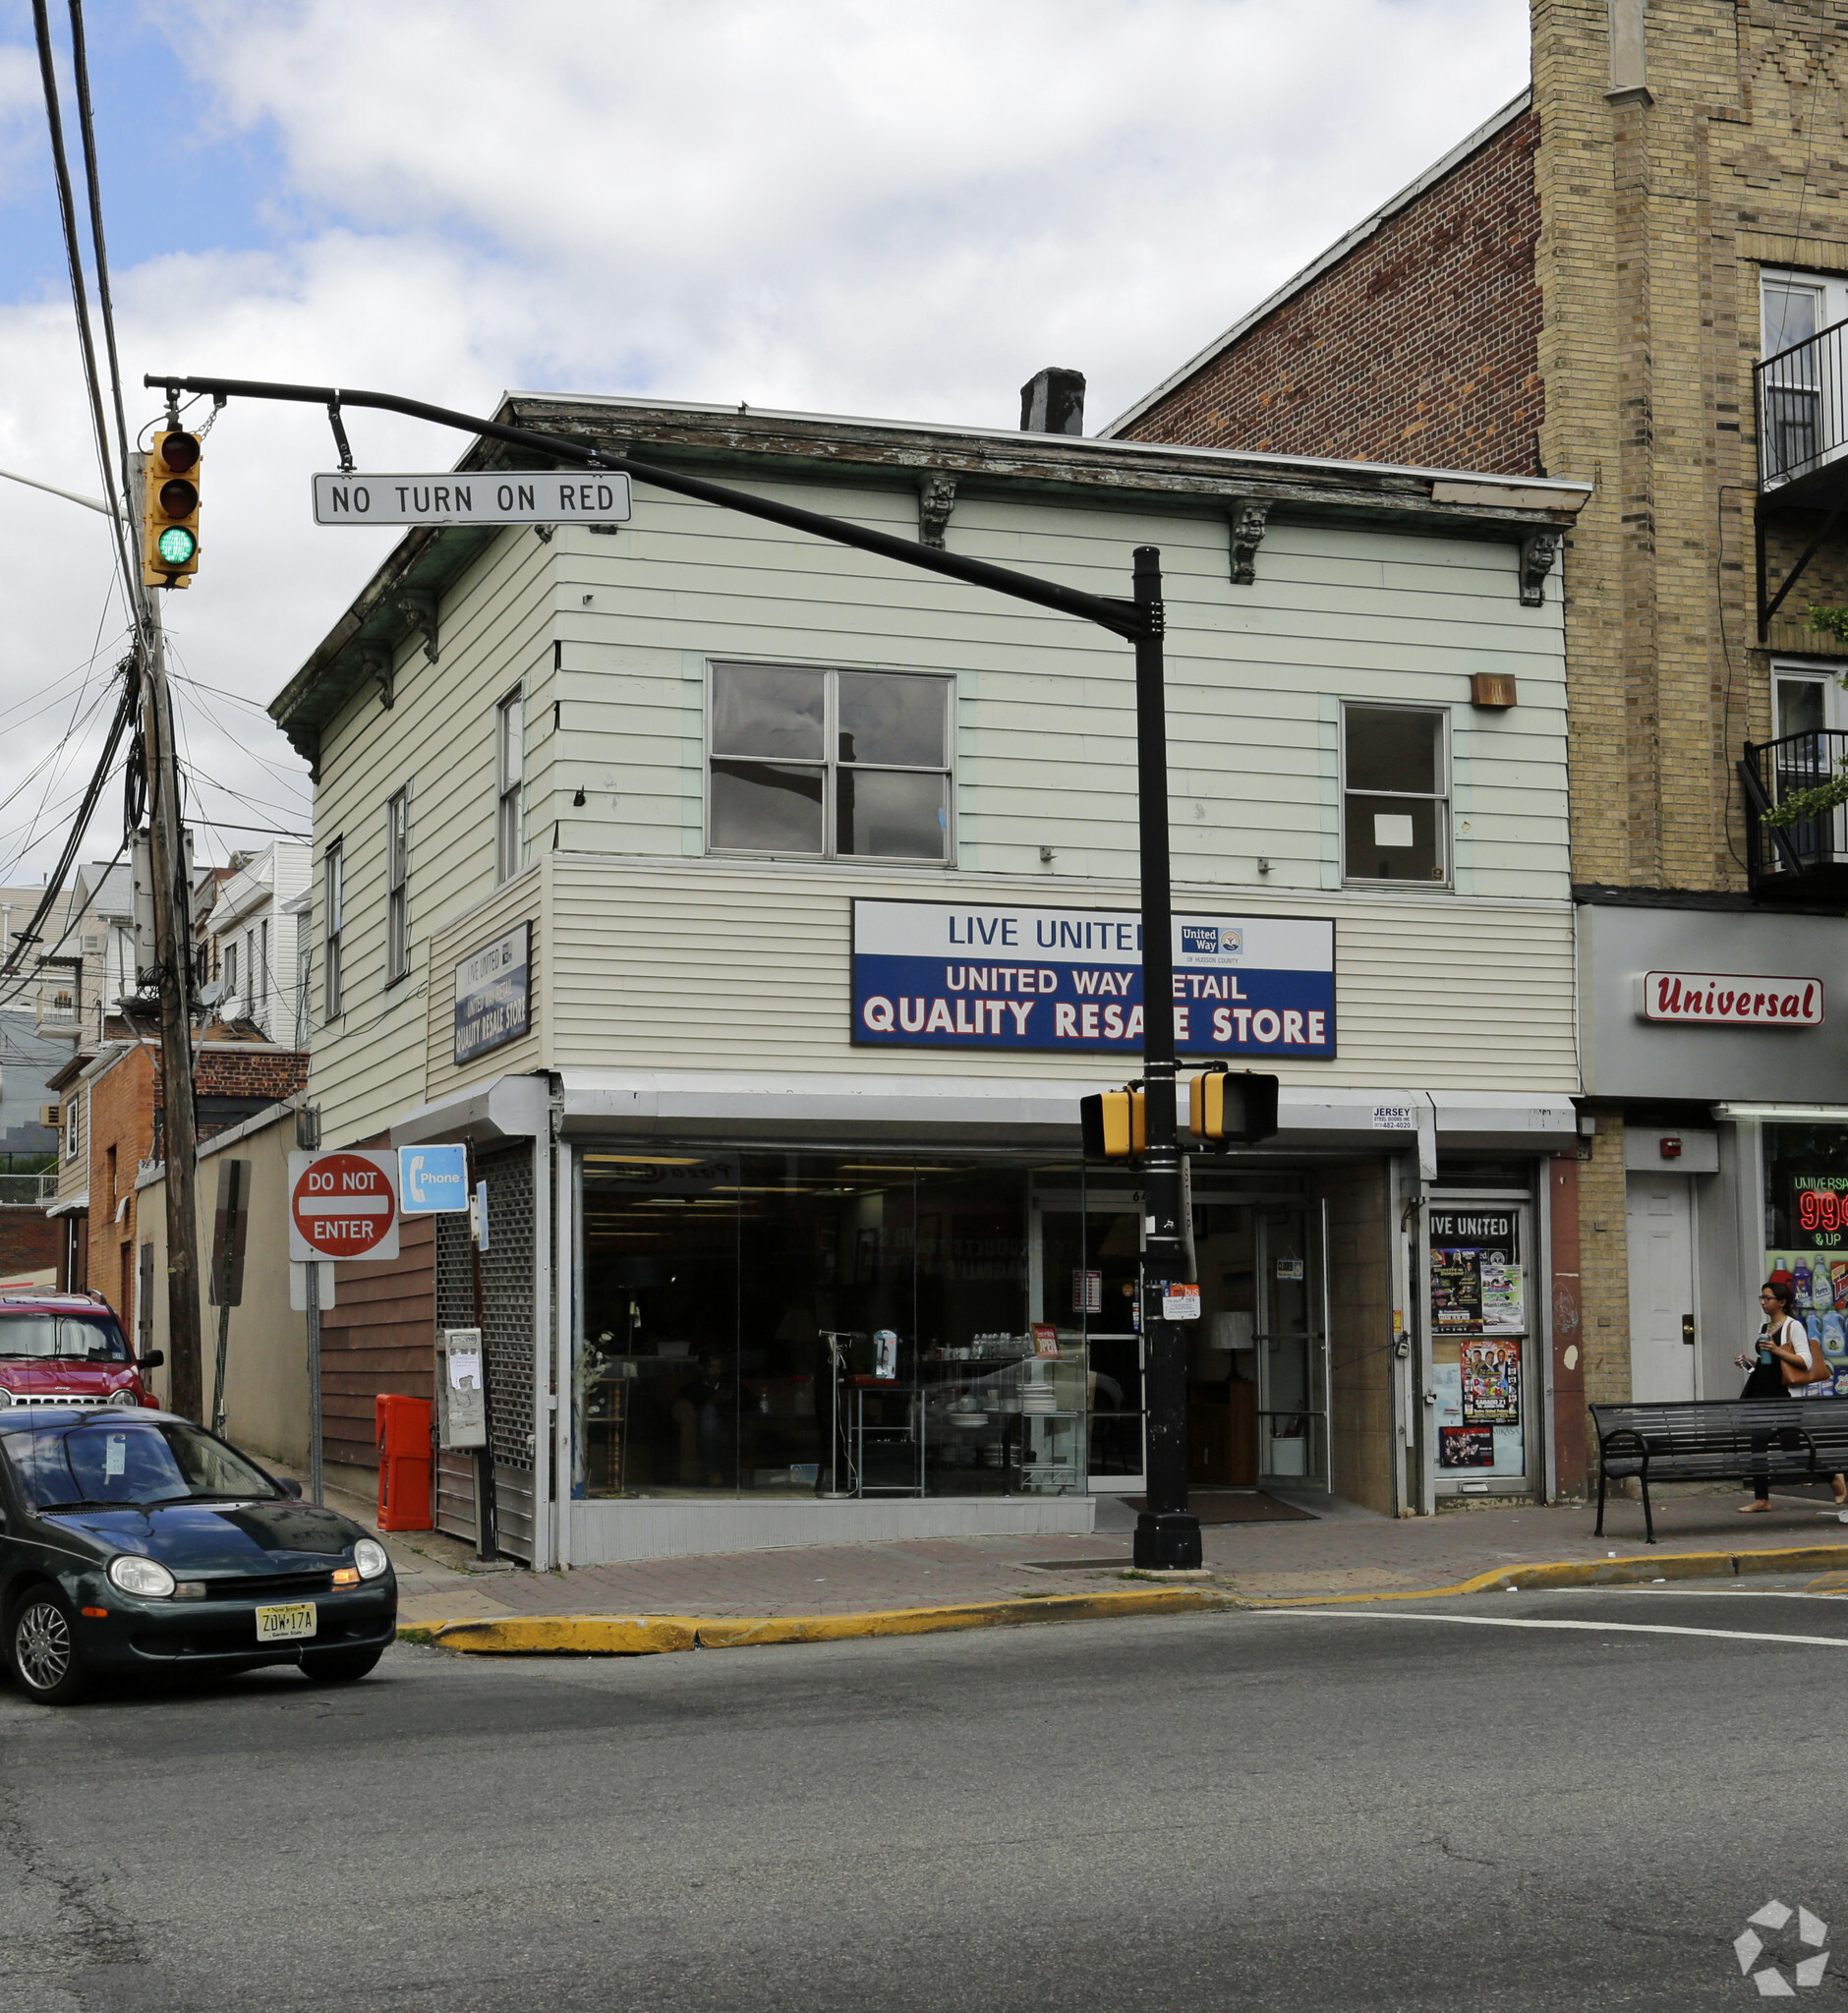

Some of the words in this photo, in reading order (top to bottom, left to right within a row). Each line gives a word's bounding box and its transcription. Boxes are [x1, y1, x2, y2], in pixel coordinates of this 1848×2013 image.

[332, 486, 371, 513] NO
[394, 486, 473, 513] TURN
[496, 485, 536, 511] ON
[559, 485, 613, 511] RED
[949, 915, 1018, 947] LIVE
[1036, 919, 1143, 951] UNITE
[1183, 928, 1217, 940] United
[1196, 940, 1217, 953] Way
[467, 960, 479, 984] LIVE
[480, 948, 499, 978] UNITED
[946, 964, 1059, 995] UNITED
[1071, 969, 1134, 997] WAY
[1172, 973, 1247, 1001] ETAIL
[466, 994, 485, 1019] UNITED
[1657, 976, 1815, 1018] Universal
[455, 1018, 481, 1054] QUALITY
[482, 1006, 504, 1041] RESALE
[505, 995, 526, 1029] STORE
[862, 995, 1035, 1037] QUALITY
[1055, 1001, 1190, 1041] RESAE
[1212, 1006, 1326, 1045] STORE
[1373, 1108, 1411, 1117] JERSEY
[308, 1172, 334, 1191] DO
[342, 1172, 377, 1190] NOT
[420, 1172, 460, 1185] Phone
[1794, 1177, 1848, 1190] UNIVERSA
[314, 1220, 375, 1239] ENTER
[1430, 1216, 1453, 1235] IVE
[1458, 1217, 1509, 1236] UNITED
[1816, 1233, 1823, 1246] &
[1824, 1233, 1842, 1246] UP
